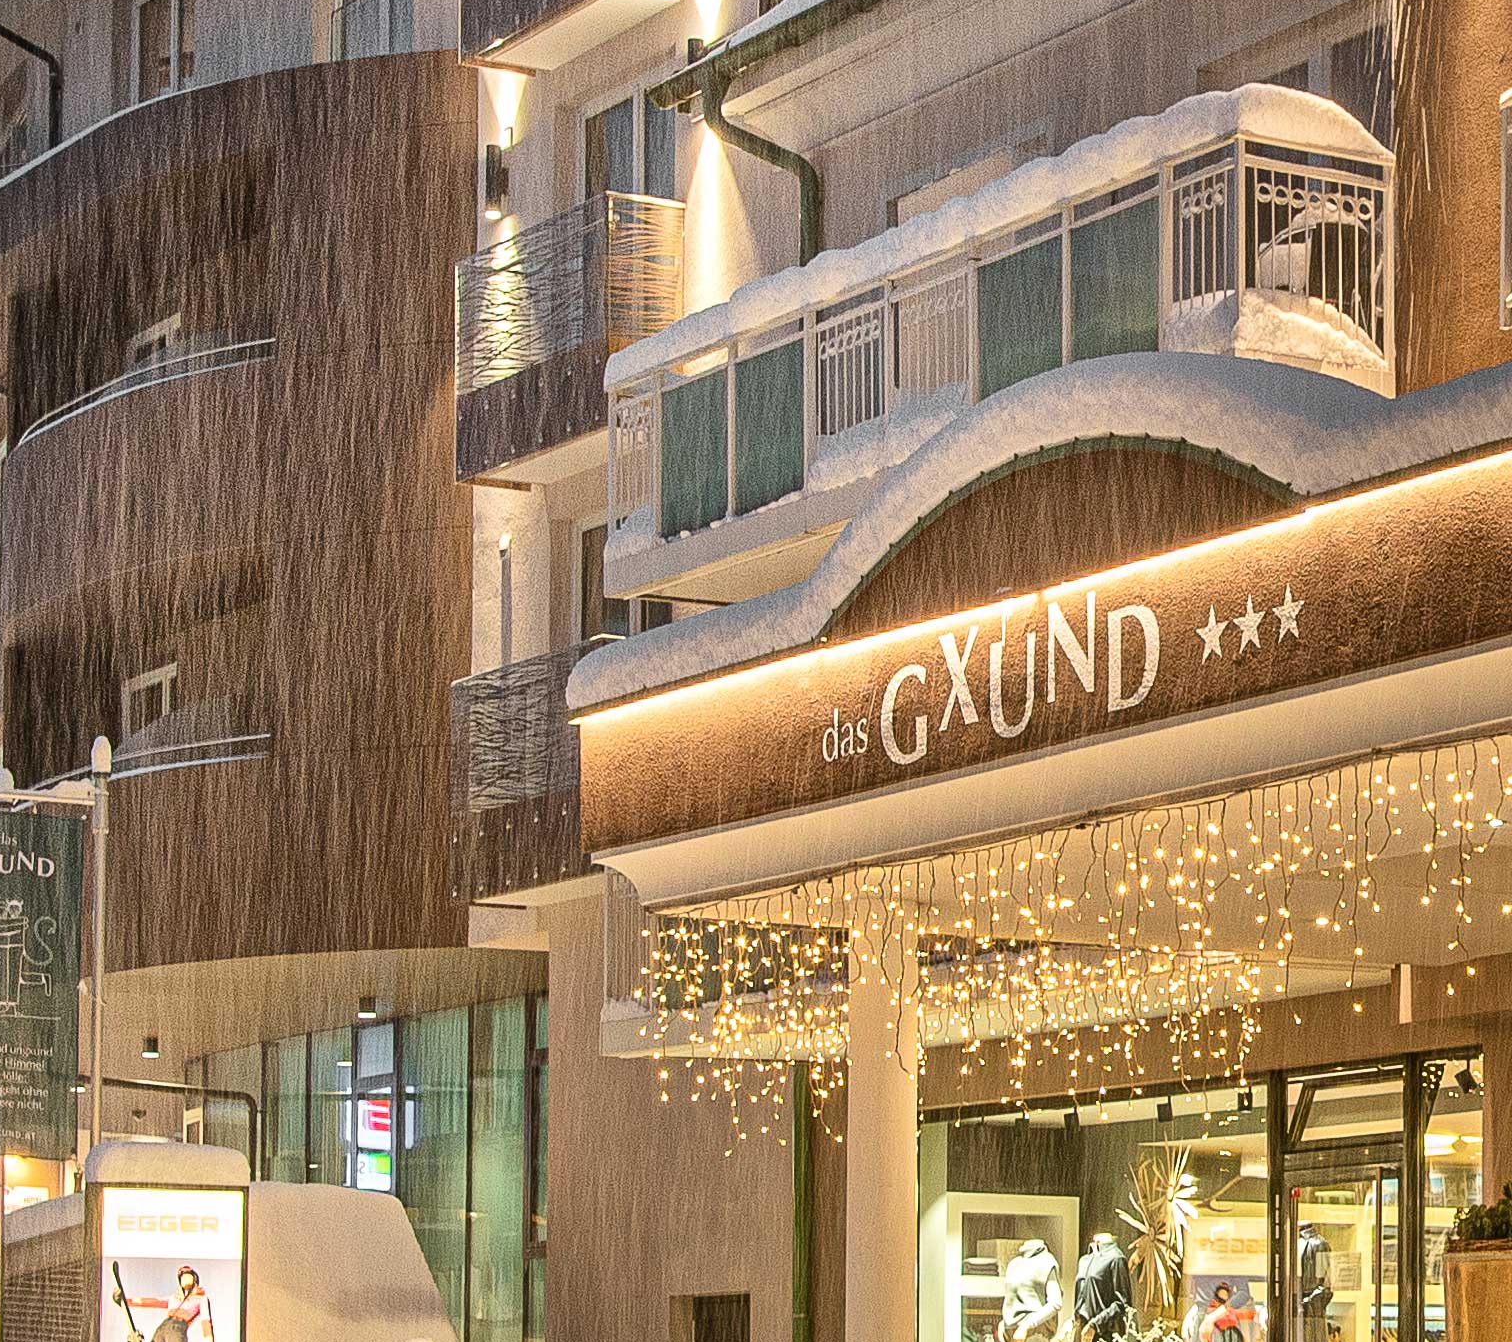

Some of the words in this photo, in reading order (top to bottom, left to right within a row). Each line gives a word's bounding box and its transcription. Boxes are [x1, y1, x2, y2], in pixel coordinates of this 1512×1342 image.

[822, 707, 869, 762] das
[880, 590, 1161, 766] GXUND
[117, 1215, 219, 1233] EGGER
